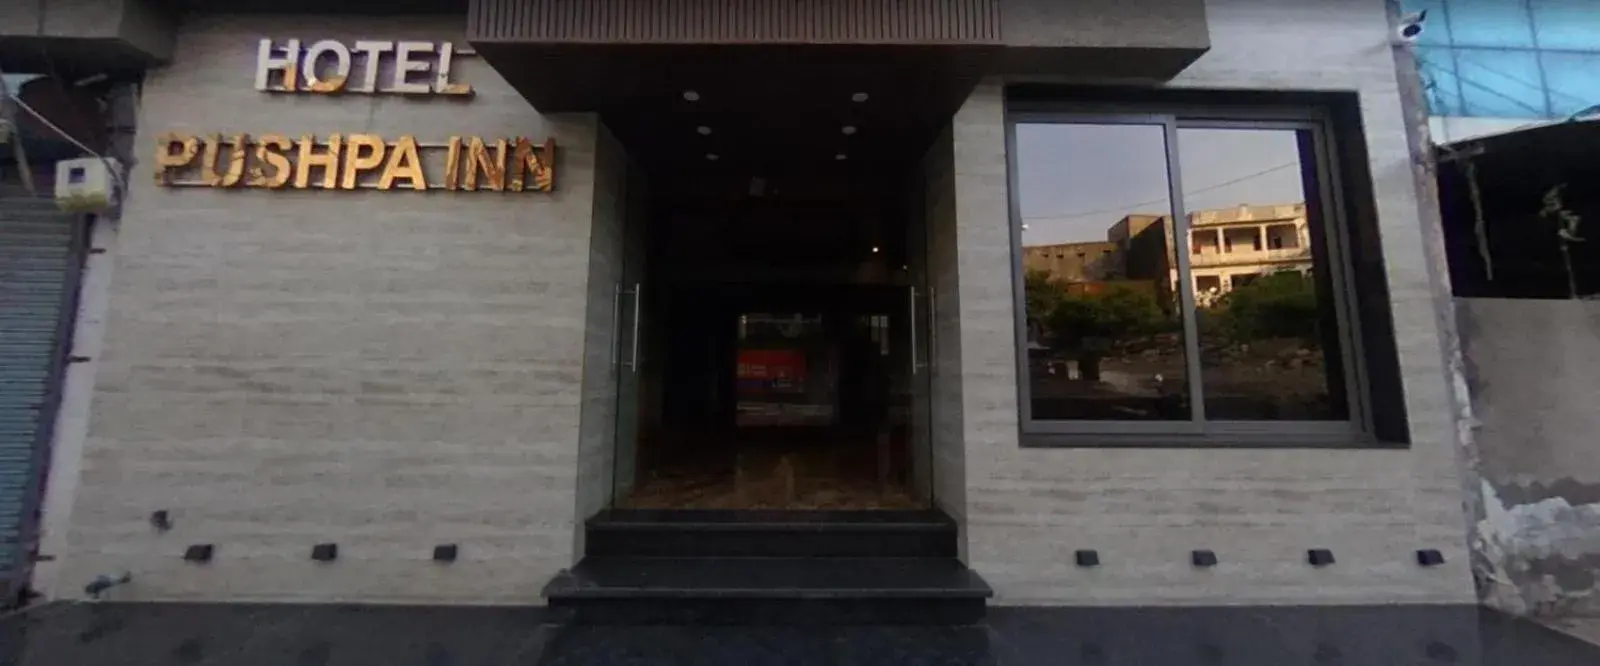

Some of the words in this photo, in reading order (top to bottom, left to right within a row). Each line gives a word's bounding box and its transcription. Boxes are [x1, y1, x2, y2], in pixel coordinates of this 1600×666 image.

[255, 38, 474, 95] HOTEL
[153, 132, 428, 190] PUSHPA
[444, 134, 556, 192] INN
